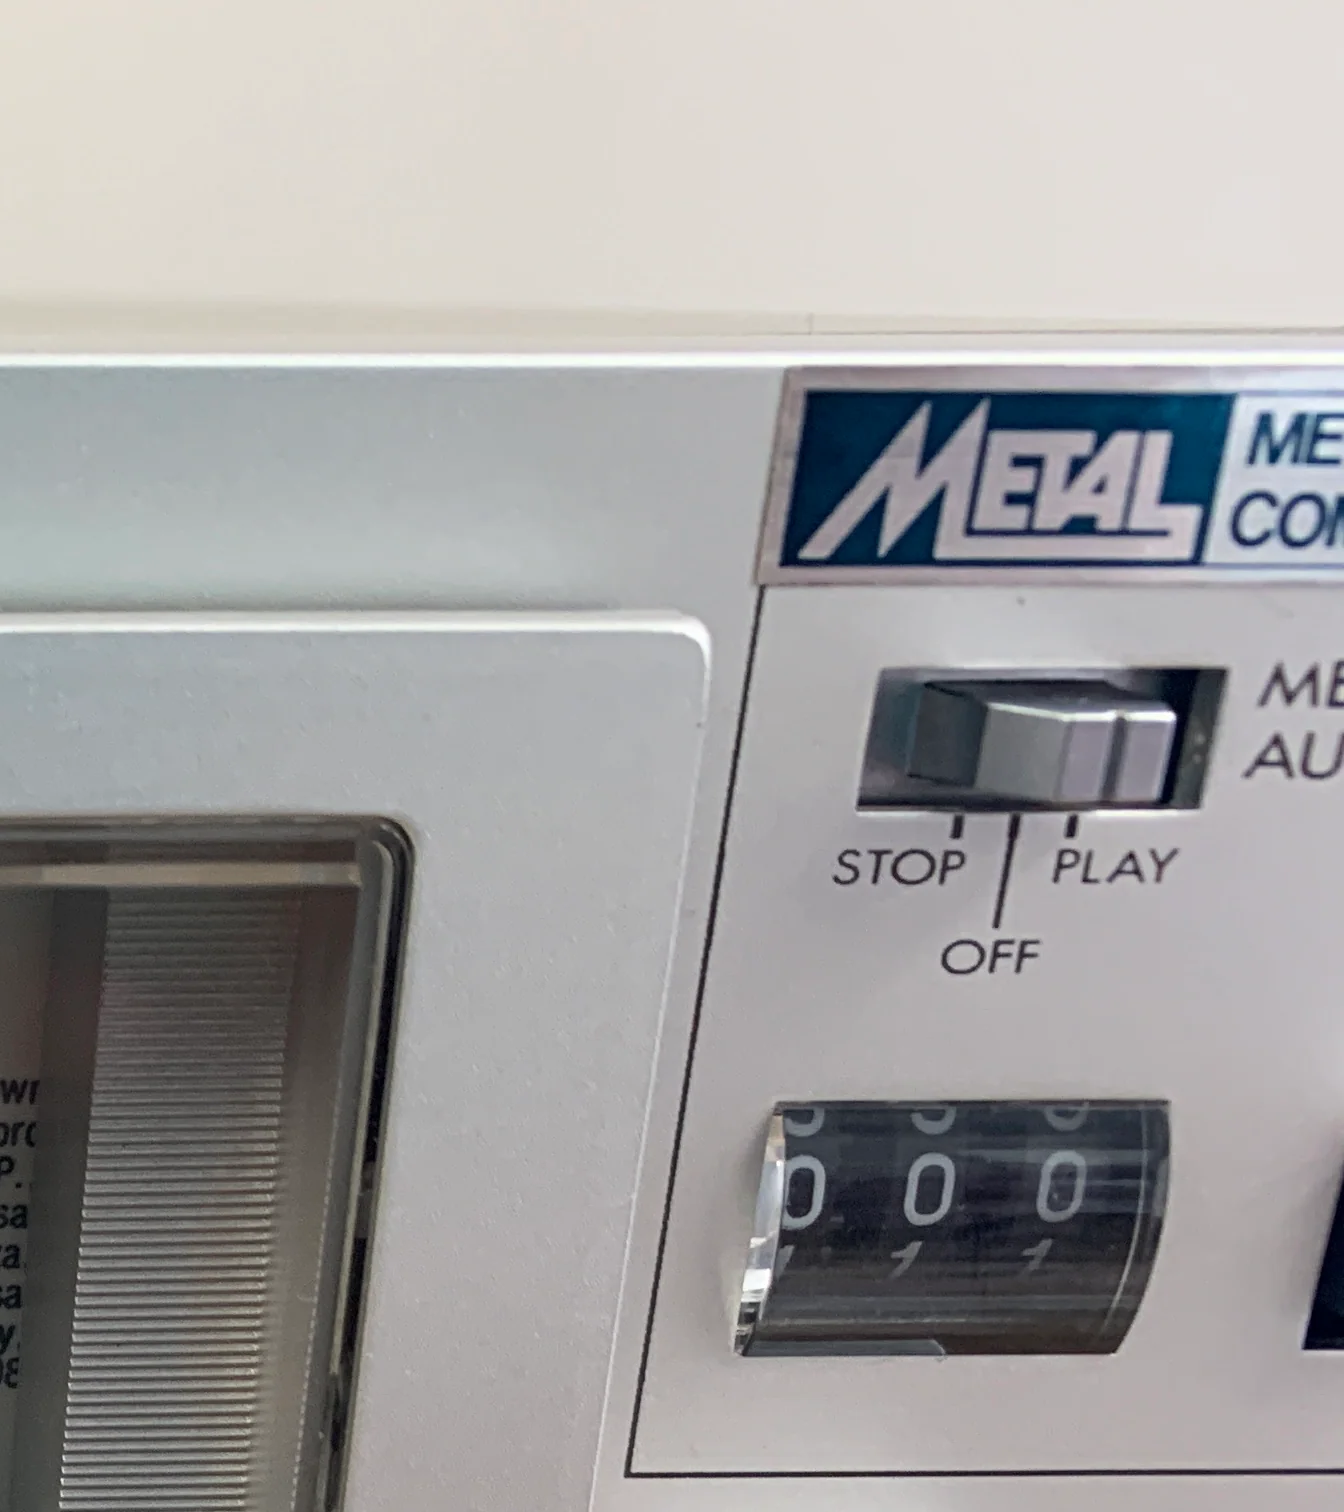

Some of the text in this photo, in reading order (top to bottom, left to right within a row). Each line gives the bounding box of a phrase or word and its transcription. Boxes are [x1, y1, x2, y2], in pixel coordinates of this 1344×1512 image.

[798, 396, 1204, 560] METAL
[831, 848, 1179, 887] STOP PLAY
[940, 938, 1042, 976] OFF
